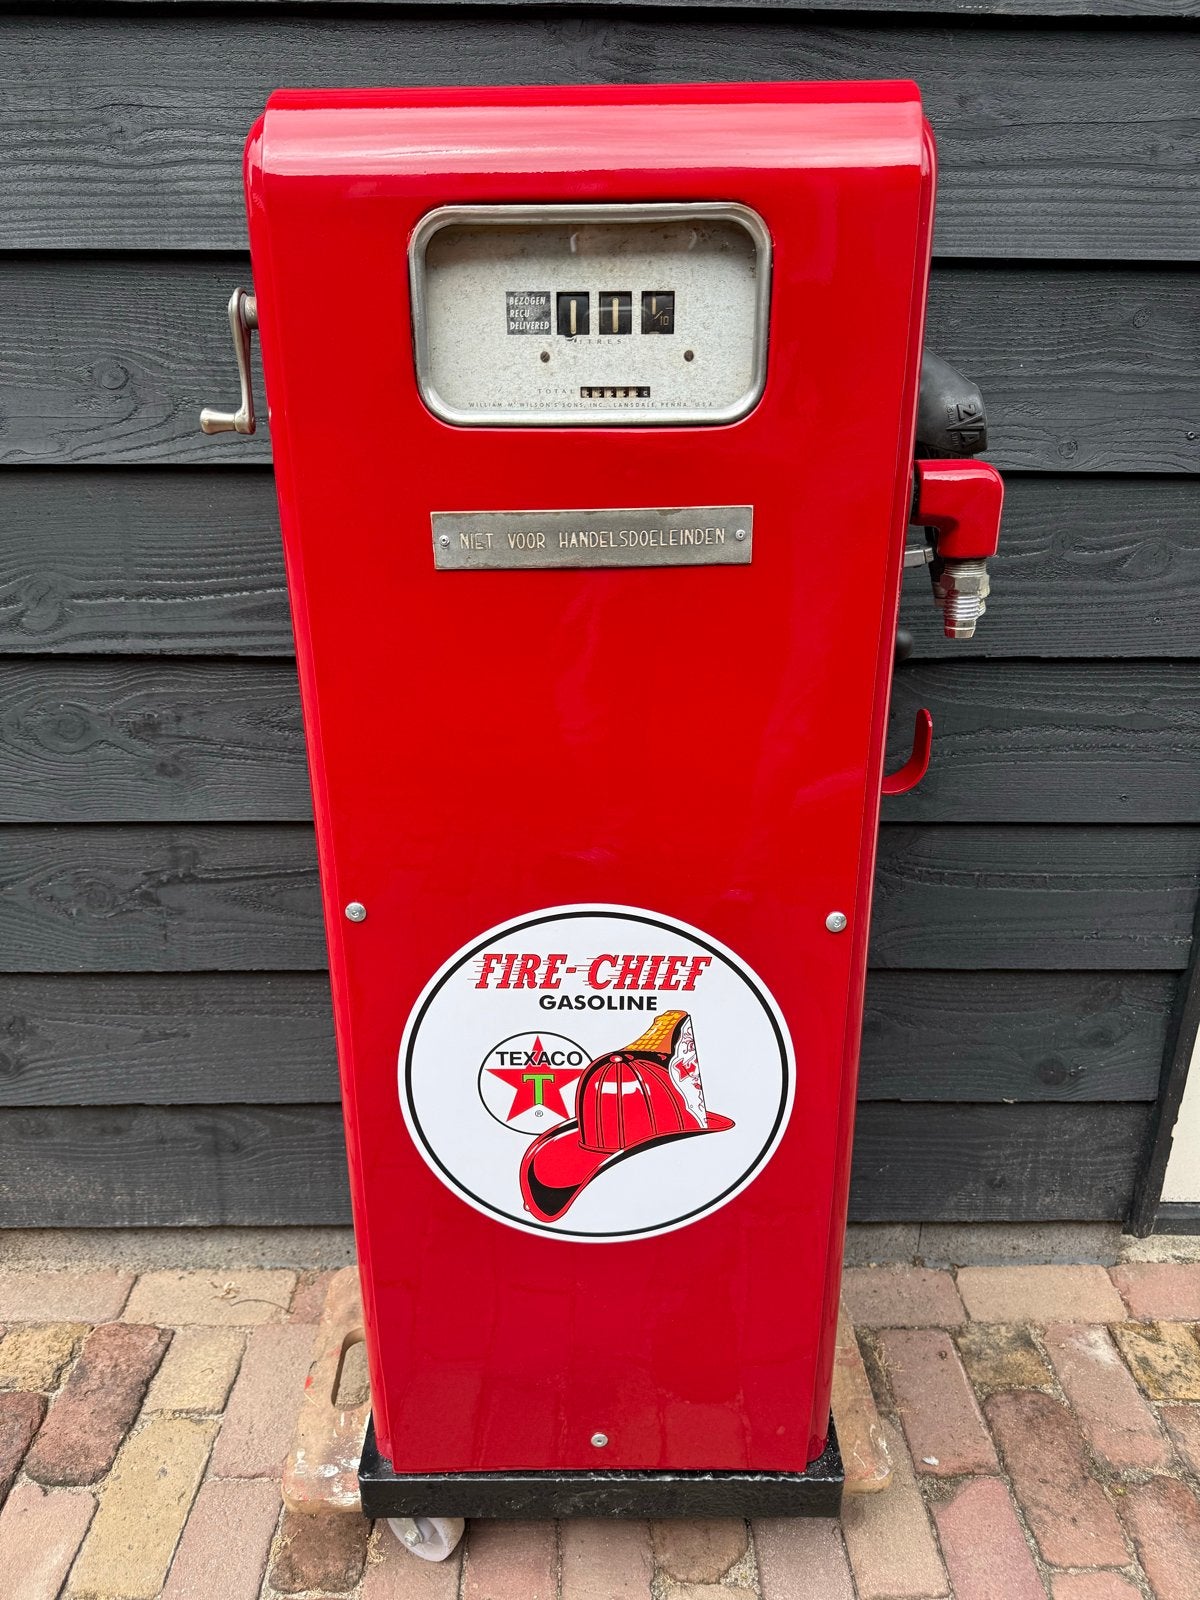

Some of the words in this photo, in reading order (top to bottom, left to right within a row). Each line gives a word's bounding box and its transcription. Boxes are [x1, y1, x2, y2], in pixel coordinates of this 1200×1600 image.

[509, 296, 546, 306] BEZOGEN
[510, 321, 550, 331] DELIVERED
[460, 531, 494, 550] NIET
[507, 532, 545, 549] VOOR
[559, 527, 725, 549] HANDELSDOELEINDEN
[539, 994, 658, 1011] GASOLINE
[495, 1050, 583, 1067] TEXACO
[522, 1073, 555, 1105] T
